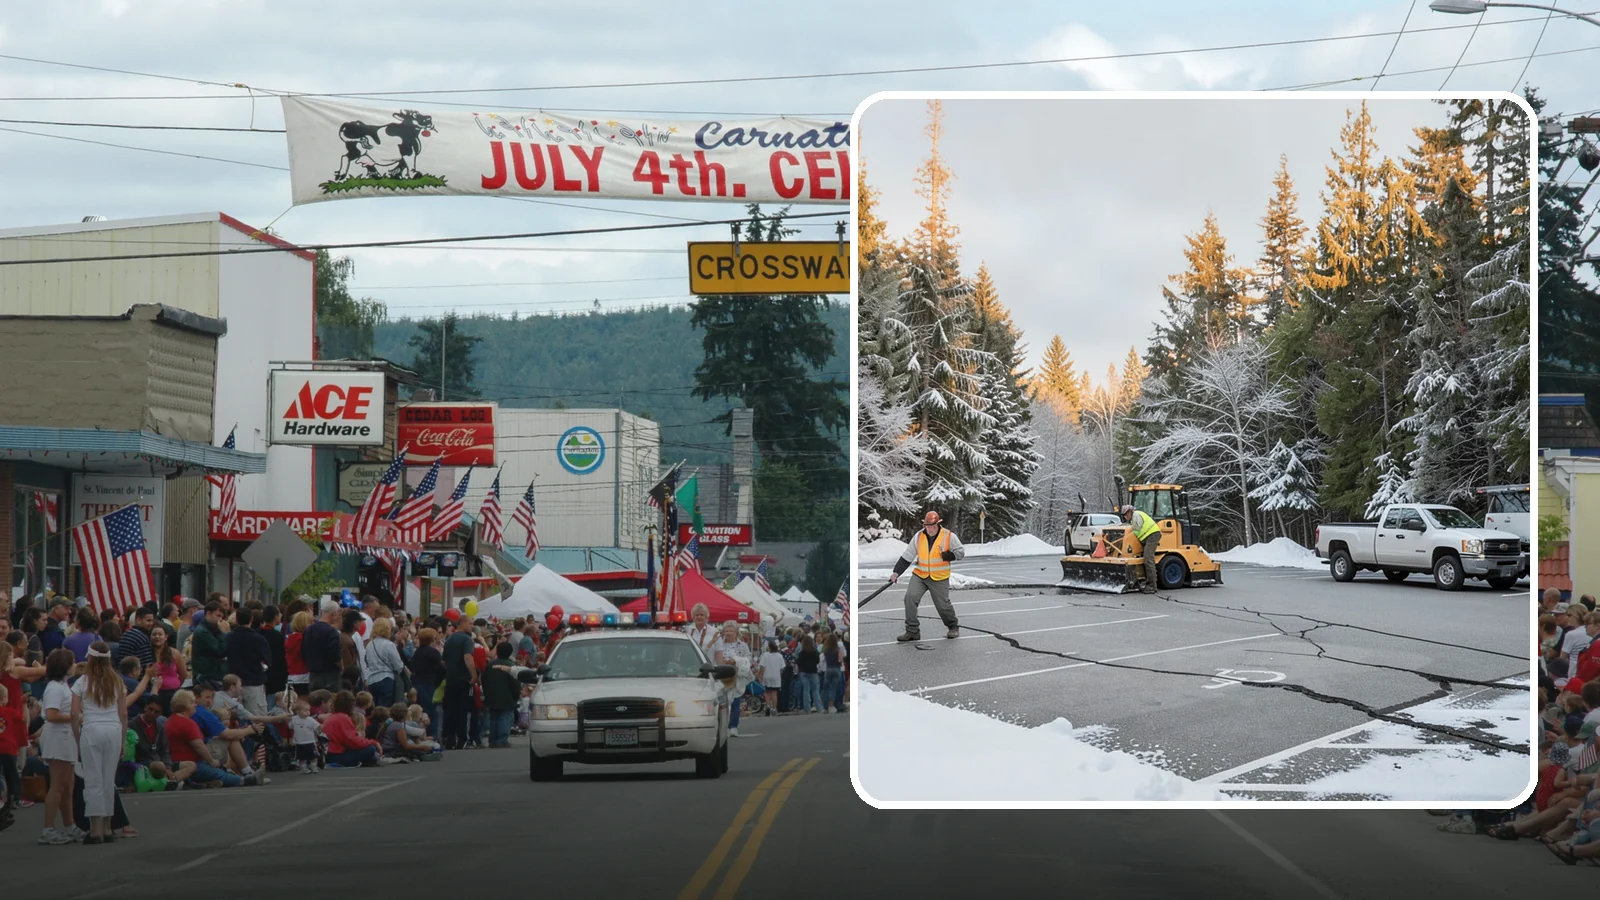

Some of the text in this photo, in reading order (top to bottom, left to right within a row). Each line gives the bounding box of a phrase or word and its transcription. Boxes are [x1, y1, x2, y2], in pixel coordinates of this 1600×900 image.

[481, 140, 605, 192] JULY
[632, 149, 746, 198] 4th.
[697, 253, 850, 280] CROSSWA
[282, 380, 373, 420] ACE
[406, 409, 453, 422] CEDAR
[283, 421, 371, 436] Hardware
[416, 428, 477, 447] Coca-Cola
[353, 467, 385, 480] Simpl
[83, 485, 155, 495] St. Vincent de Paul
[212, 517, 330, 535] HARDARE
[688, 526, 742, 535] CRNATION
[699, 535, 730, 543] GLASS
